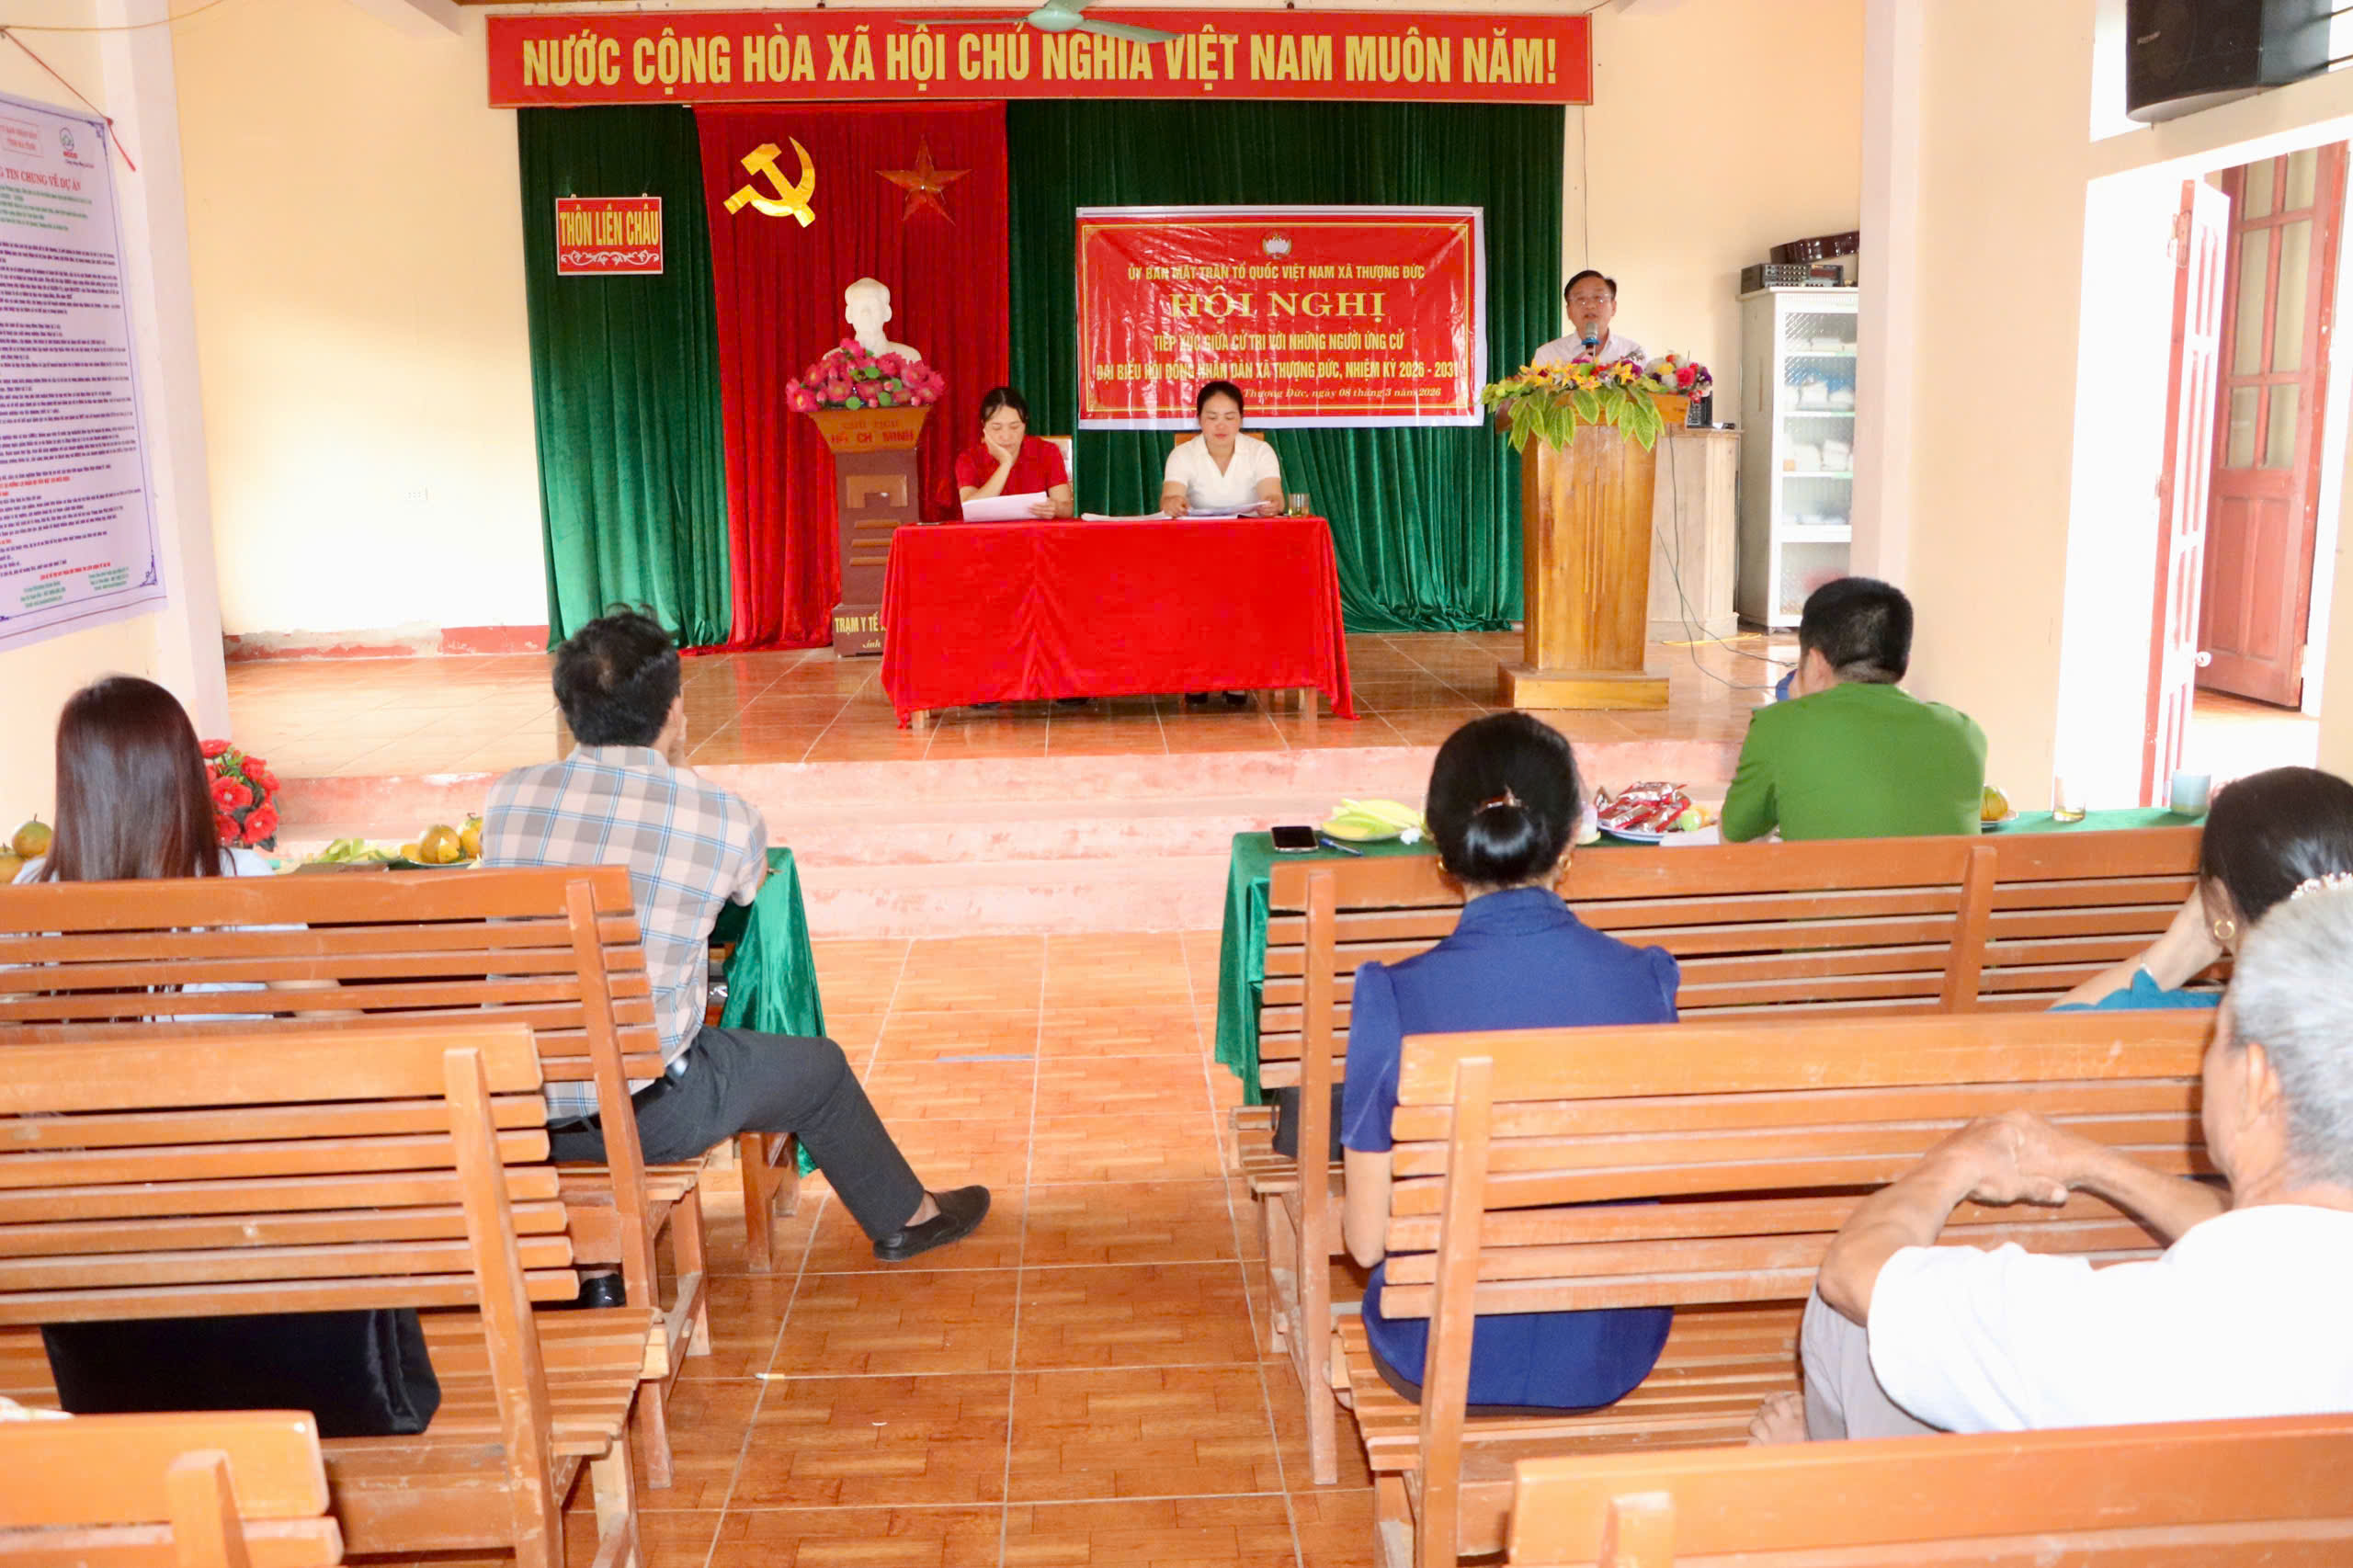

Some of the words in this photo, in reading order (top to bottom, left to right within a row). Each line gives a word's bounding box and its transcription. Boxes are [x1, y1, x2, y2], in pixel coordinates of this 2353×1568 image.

[523, 29, 620, 86] NƯỚC
[633, 28, 731, 95] CỘNG
[744, 24, 815, 83] HÒA
[827, 25, 875, 81] XÃ
[887, 24, 946, 91] HỘI
[959, 22, 1029, 80] CHỦ
[1165, 24, 1238, 90] VIỆT
[1251, 35, 1332, 81] NAM
[1346, 27, 1449, 84] MUÔN
[1463, 28, 1556, 84] NĂM!
[21, 171, 47, 184] CHUNG
[559, 204, 592, 246] THÔN
[596, 203, 623, 246] LIÊN
[626, 203, 659, 246] CHÂU
[1146, 267, 1169, 279] BAN
[1249, 262, 1279, 279] QUỐC
[1282, 264, 1305, 281] VIỆT
[1309, 266, 1335, 278] NAM
[1338, 264, 1353, 278] XÃ
[1356, 265, 1399, 282] THƯỢNG
[1403, 263, 1425, 278] ĐỨC
[1169, 285, 1254, 324] HỘI
[1267, 292, 1386, 323] NGHỊ
[1249, 335, 1266, 350] TRI
[1290, 331, 1325, 349] NHỮNG
[1329, 330, 1361, 349] NGƯỜI
[1365, 331, 1386, 349] ỨNG
[1231, 360, 1253, 379] DÂN
[1256, 359, 1269, 379] XÃ
[1273, 360, 1314, 381] THƯỢNG
[1318, 358, 1343, 380] ĐỨC,
[1346, 358, 1380, 381] NHIỆM
[1399, 361, 1425, 378] 2026
[1434, 361, 1459, 378] 2031
[1338, 388, 1350, 397] 08
[1385, 388, 1392, 397] 3
[1418, 388, 1441, 397] 2026
[835, 618, 858, 635] TRẠM
[860, 617, 866, 632] Y
[868, 611, 879, 631] TẾ
